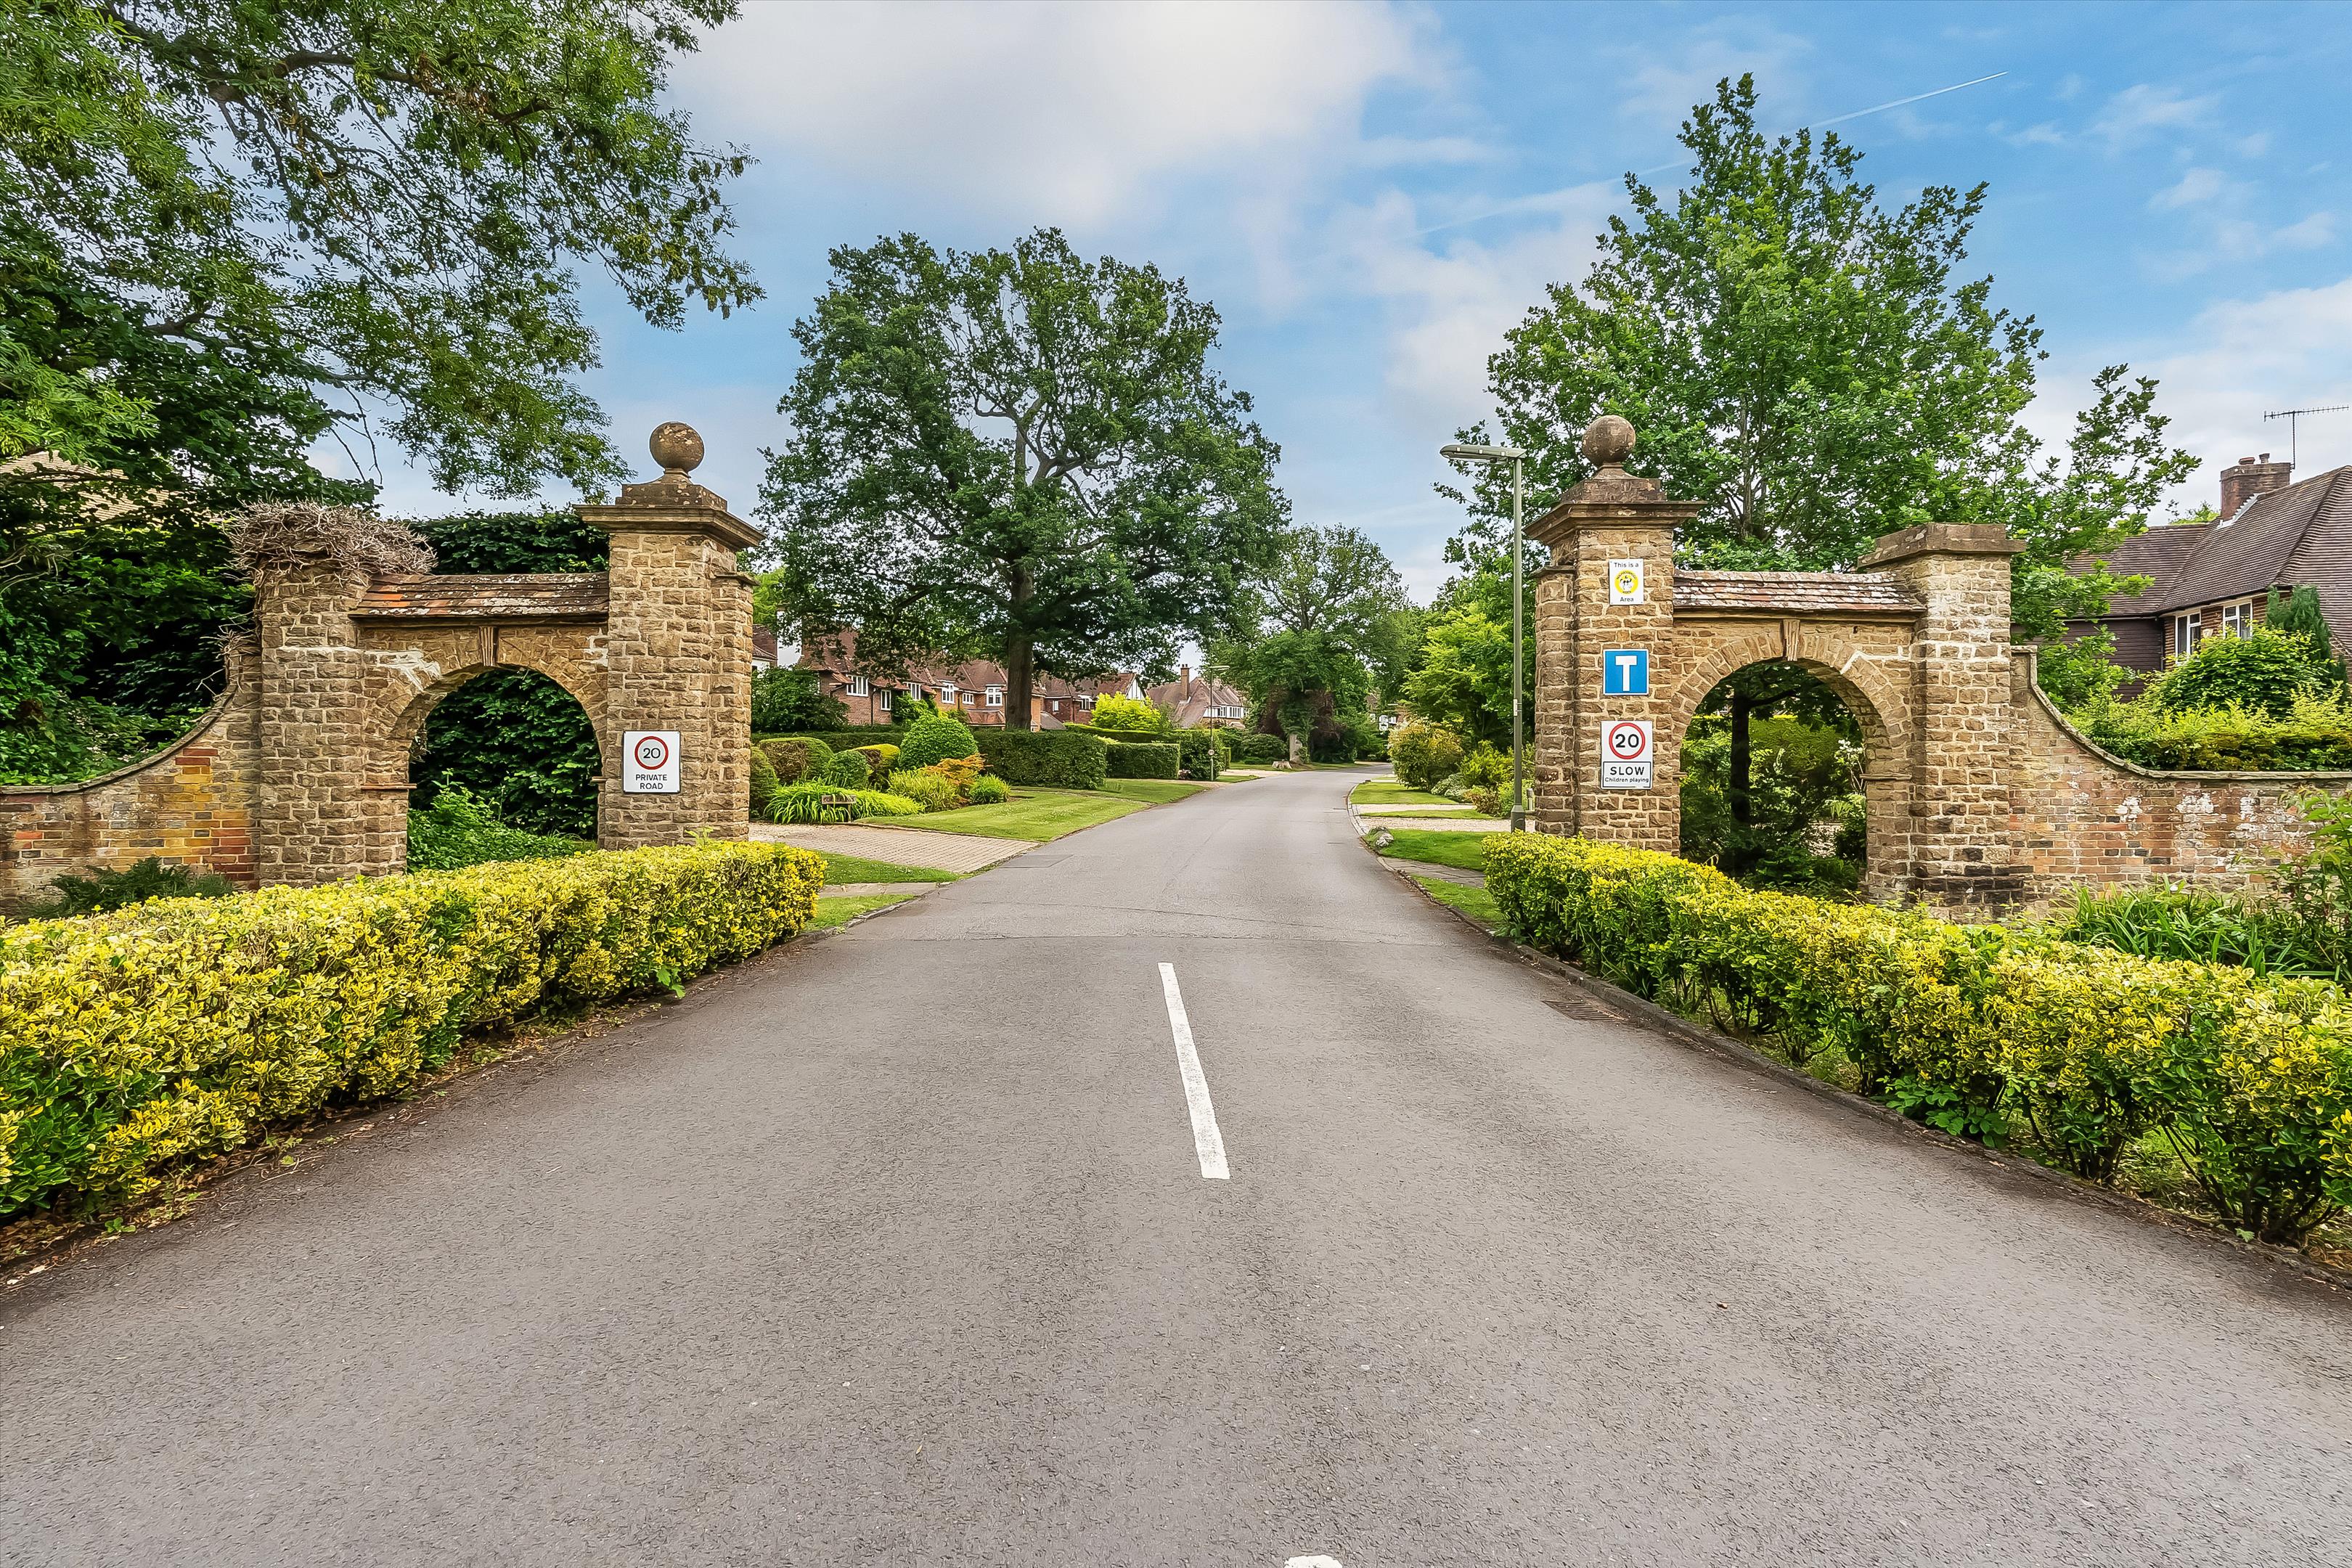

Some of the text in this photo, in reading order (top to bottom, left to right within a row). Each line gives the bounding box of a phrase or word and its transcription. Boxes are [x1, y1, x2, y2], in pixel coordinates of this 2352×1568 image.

[1615, 733, 1639, 748] 20
[643, 748, 661, 759] 20
[1609, 767, 1645, 775] SLOW
